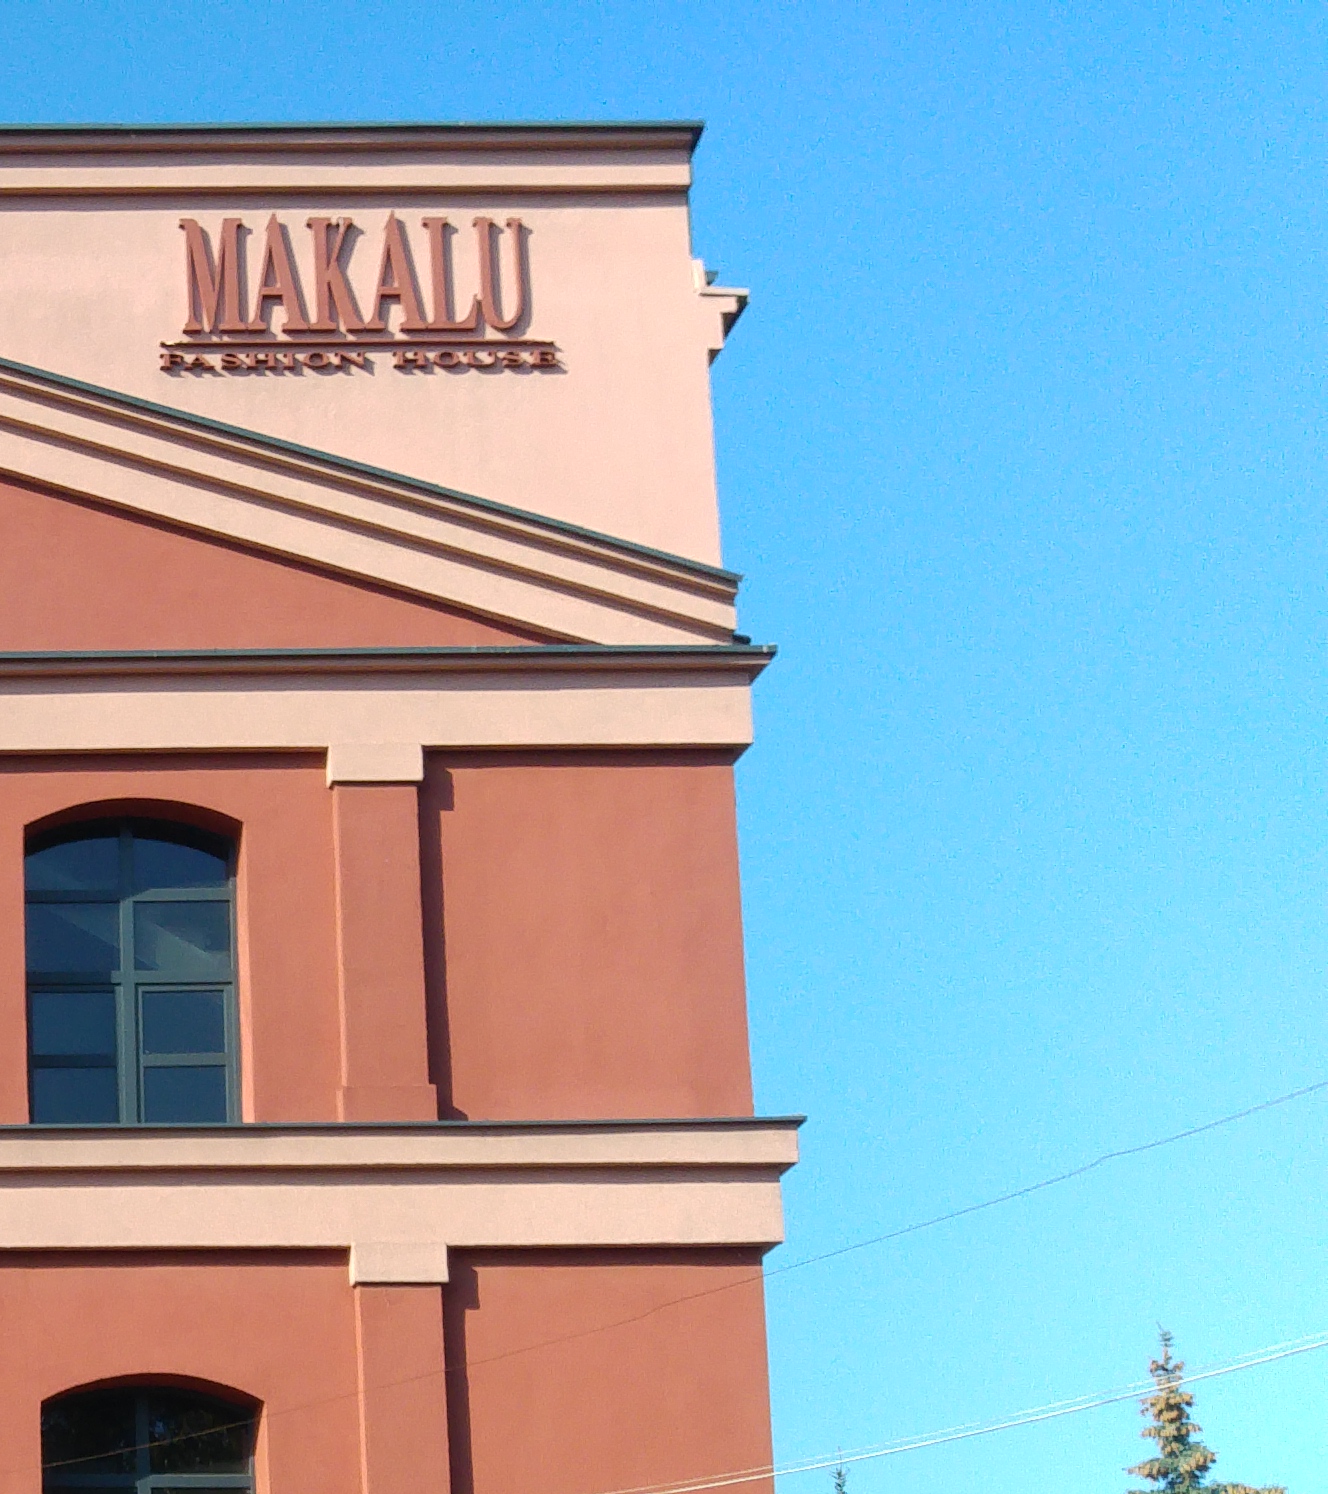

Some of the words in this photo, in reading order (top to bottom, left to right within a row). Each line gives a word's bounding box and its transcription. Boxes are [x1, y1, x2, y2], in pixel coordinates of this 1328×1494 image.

[178, 209, 523, 334] MAKALU
[159, 351, 367, 371] FASHION
[392, 349, 560, 370] HOUSE
